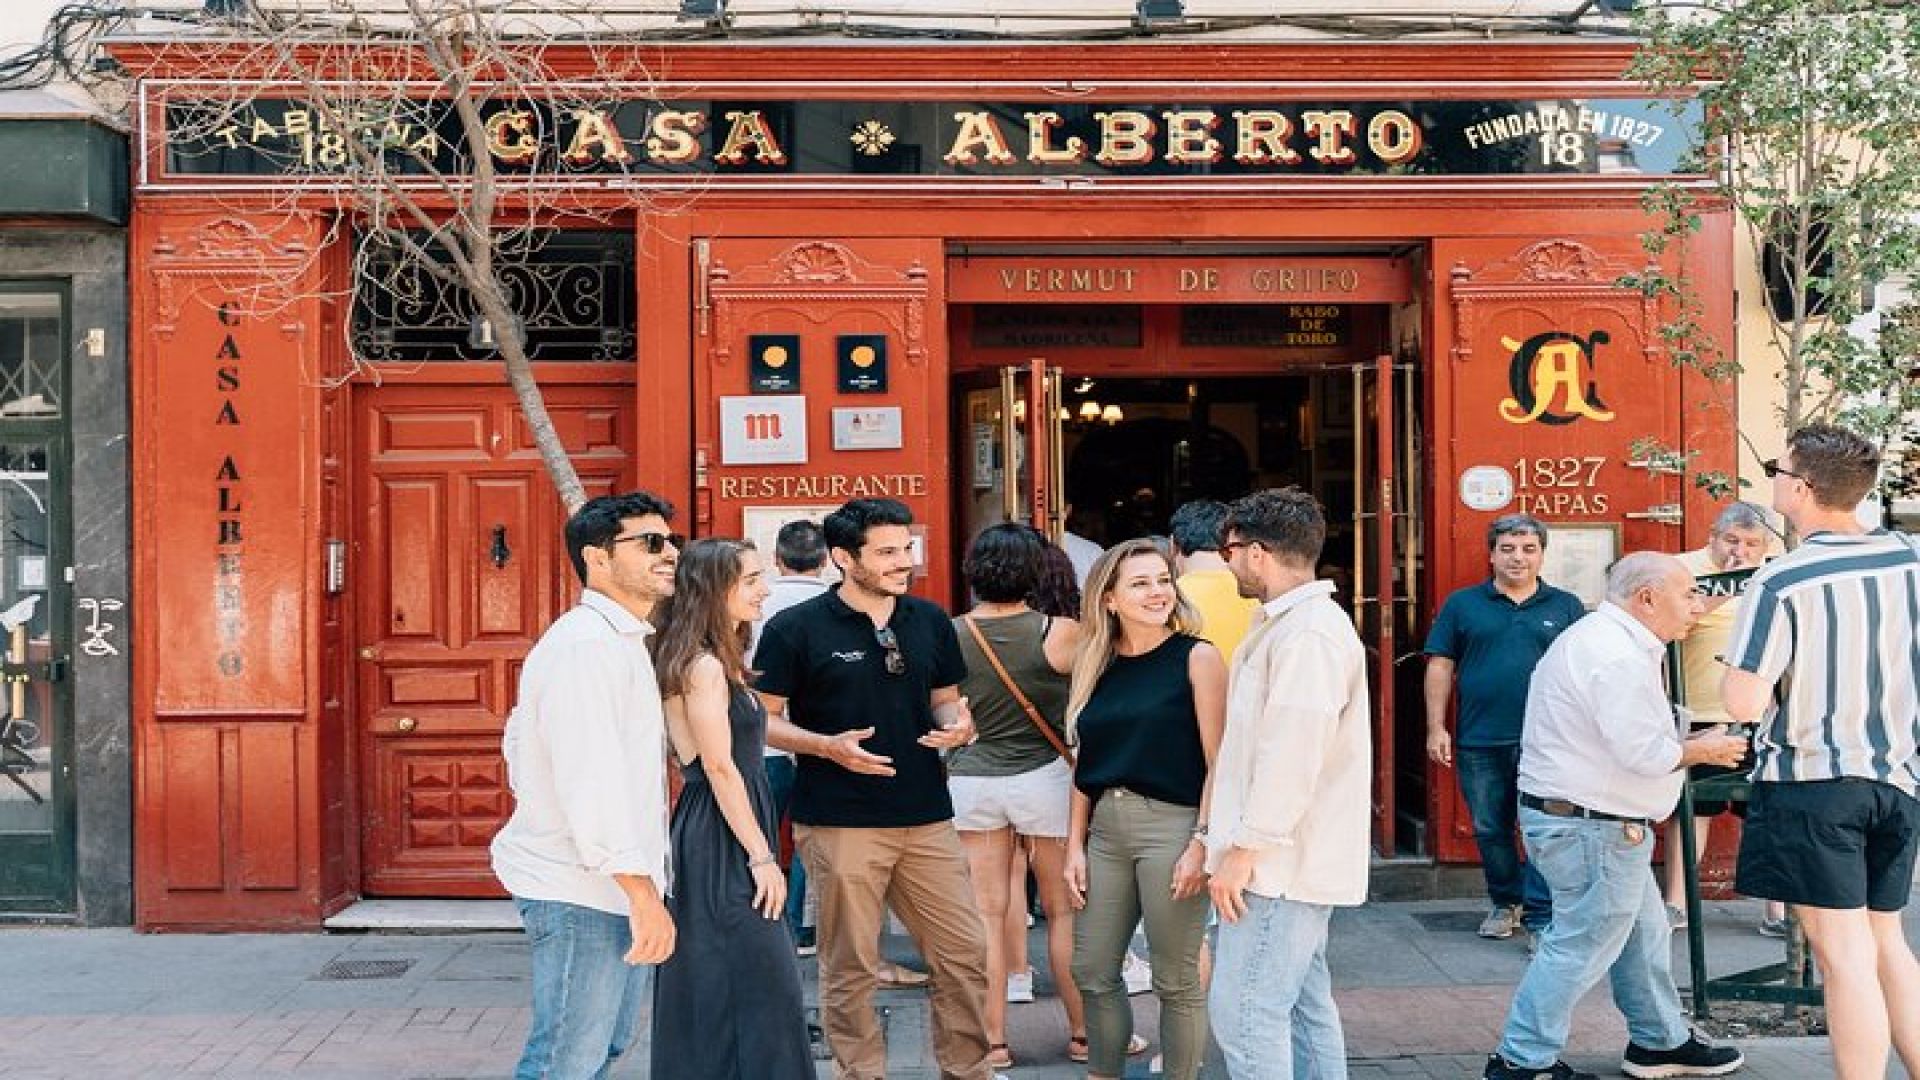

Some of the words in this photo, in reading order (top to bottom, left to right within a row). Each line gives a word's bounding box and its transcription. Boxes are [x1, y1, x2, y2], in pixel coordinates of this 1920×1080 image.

[216, 110, 438, 157] TABENA
[484, 110, 787, 166] CASA
[943, 110, 1423, 166] ALBERTO
[1464, 107, 1570, 149] FUNDADA
[1578, 106, 1607, 134] EN
[1610, 114, 1665, 147] 1827
[1538, 132, 1586, 165] 18
[999, 268, 1138, 292] VERMUT
[1179, 268, 1221, 292] DE
[1252, 268, 1360, 292] GRIFO
[1300, 319, 1326, 331] DE
[216, 301, 241, 425] CASA
[720, 474, 927, 498] RESTAURANTE
[1514, 456, 1606, 488] 1827
[1514, 494, 1609, 515] TAPAS
